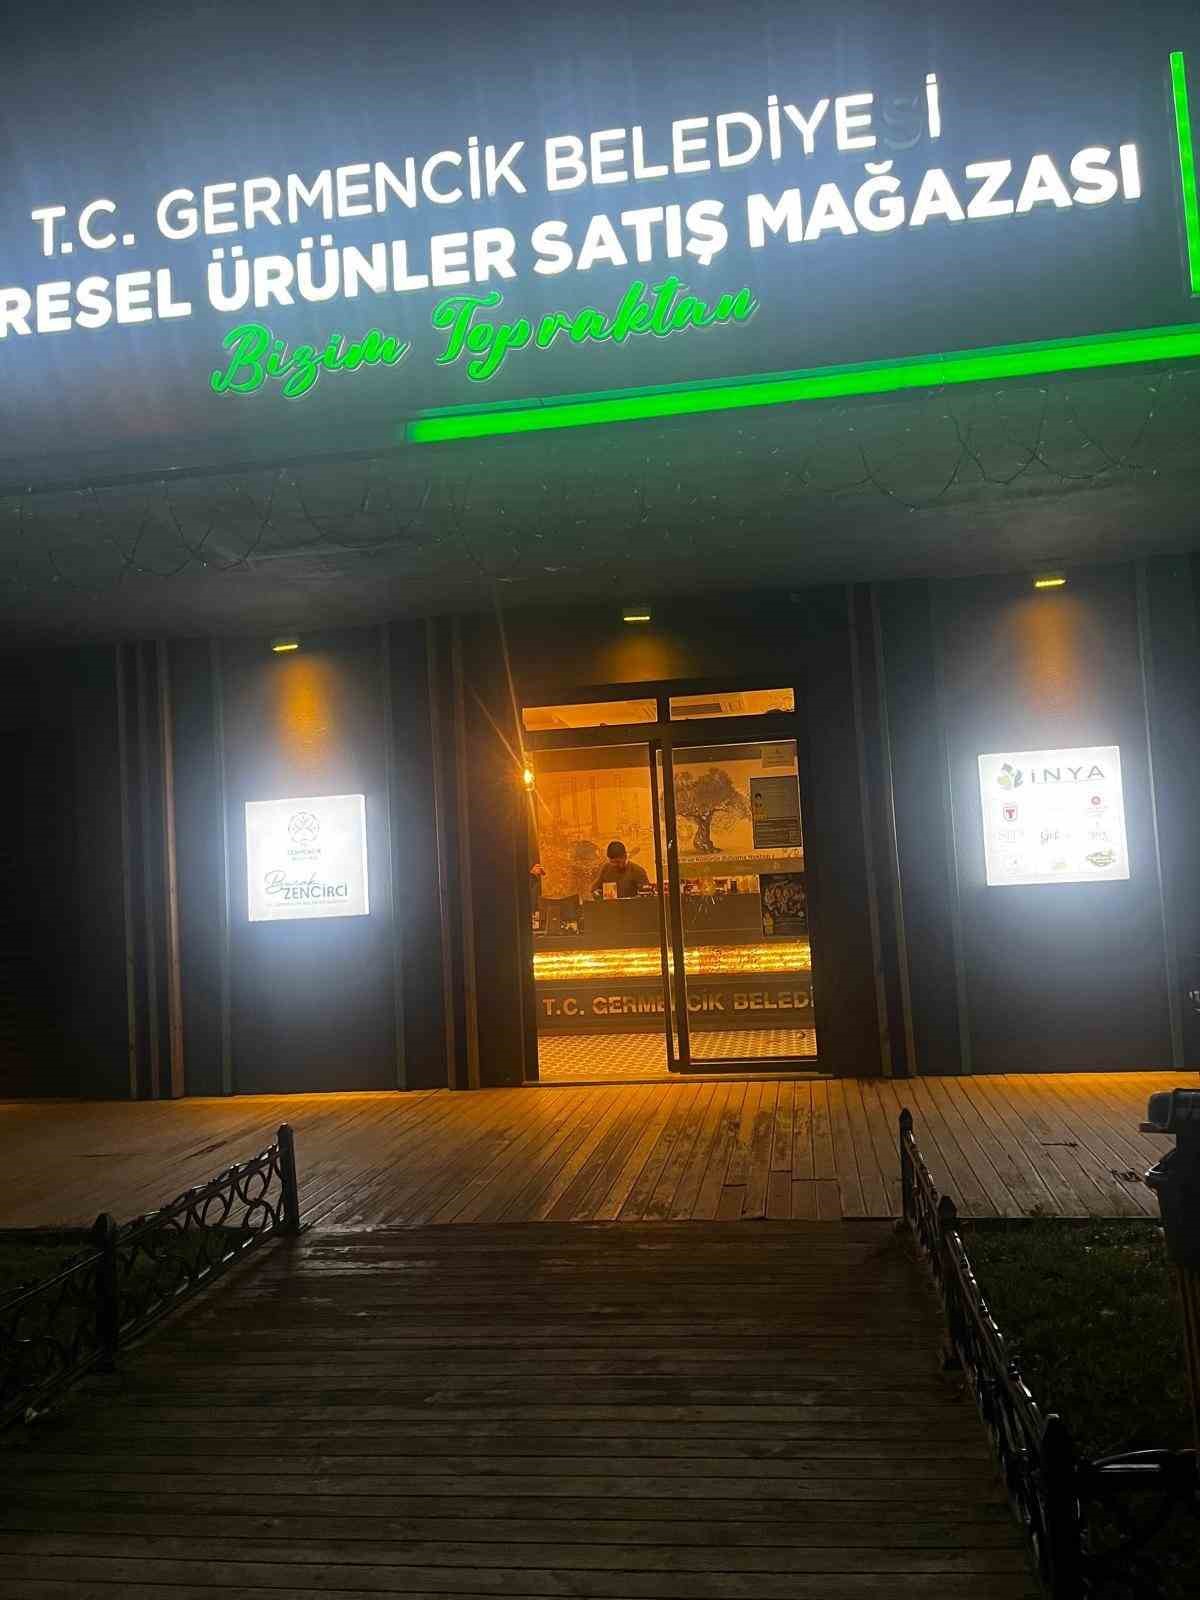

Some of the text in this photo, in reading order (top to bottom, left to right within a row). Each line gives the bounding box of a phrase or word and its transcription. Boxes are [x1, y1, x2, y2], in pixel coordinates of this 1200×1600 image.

[31, 205, 136, 257] T.C.
[156, 136, 528, 240] GERMENCİK
[207, 226, 517, 312] ÜRÜNLER
[531, 199, 728, 275] SATIŞ
[747, 143, 1142, 248] MAĞAZASI
[209, 274, 759, 399] Bizim Topraktan
[543, 998, 585, 1016] T.C.
